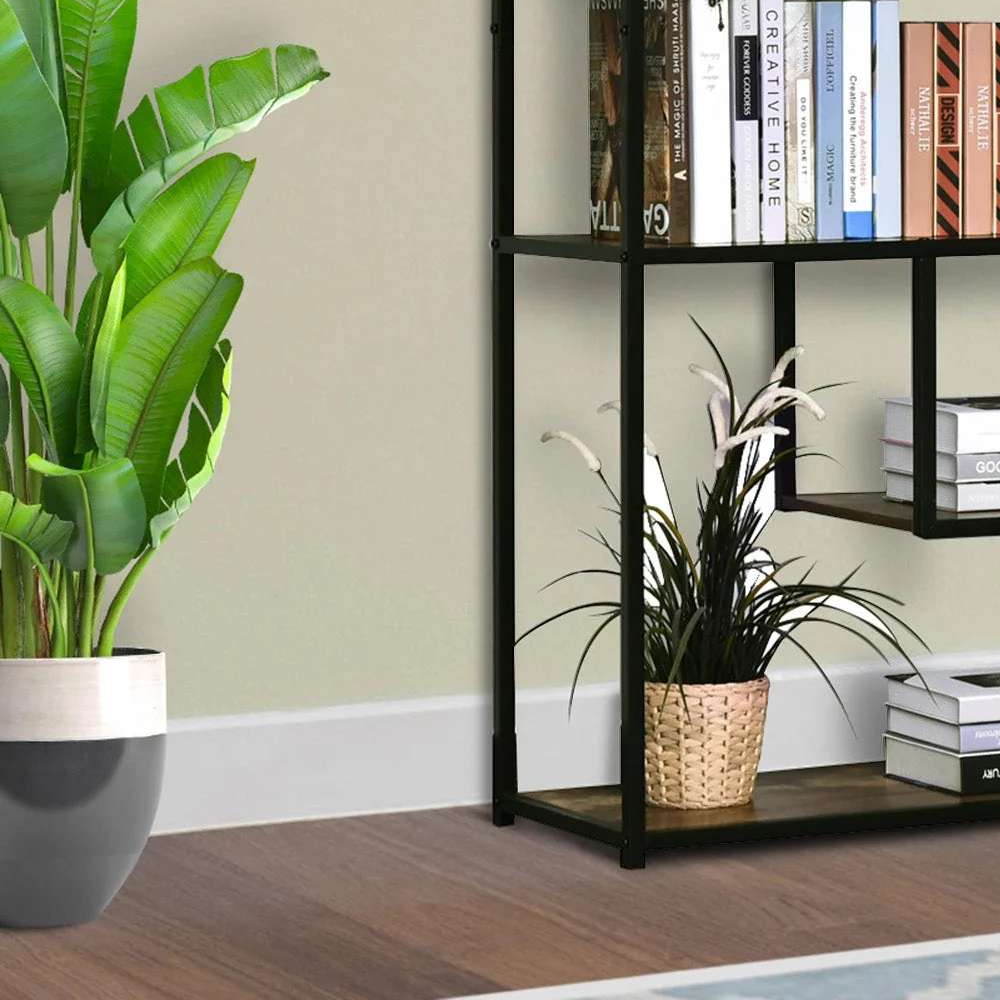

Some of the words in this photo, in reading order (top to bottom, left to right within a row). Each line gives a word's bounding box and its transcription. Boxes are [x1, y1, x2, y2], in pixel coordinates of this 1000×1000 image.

[672, 36, 680, 73] SHRUTI
[743, 39, 751, 75] FOREVER
[765, 9, 780, 127] CREATIVE
[673, 79, 680, 94] OF
[743, 77, 751, 116] GODDESS
[848, 75, 858, 114] Creating
[673, 99, 681, 138] MAGIC
[849, 116, 857, 132] the
[858, 91, 867, 137] Anderegg
[918, 86, 931, 152] NATHALIE
[941, 97, 955, 143] DESIGN
[977, 85, 990, 151] NATHALIE
[826, 143, 835, 181] MAGIC
[849, 134, 857, 173] furniture
[859, 139, 867, 186] Architects
[768, 142, 781, 207] HOME
[849, 176, 857, 203] brand
